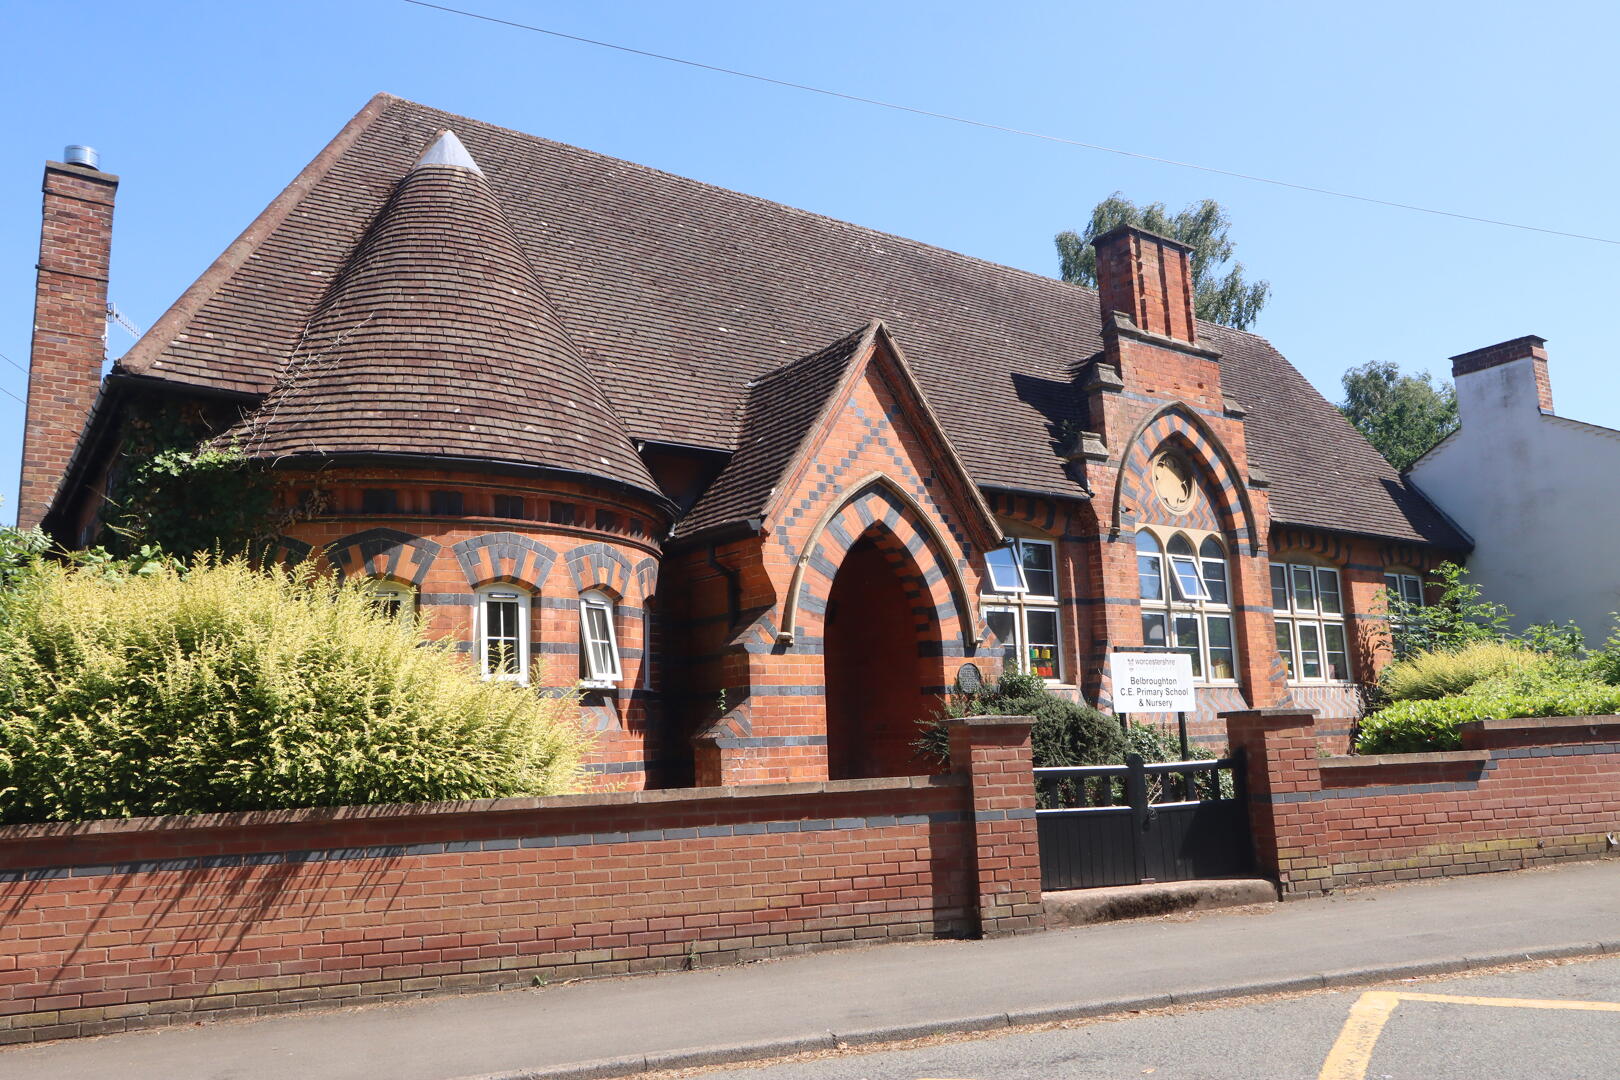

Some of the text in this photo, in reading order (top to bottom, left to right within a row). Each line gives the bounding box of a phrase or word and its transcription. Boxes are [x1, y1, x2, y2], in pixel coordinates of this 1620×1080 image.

[1135, 657, 1176, 666] worcestershire
[1130, 676, 1177, 687] Belbroughton
[1120, 687, 1189, 697] C.E. Primary School
[1138, 698, 1173, 709] & Nursery
